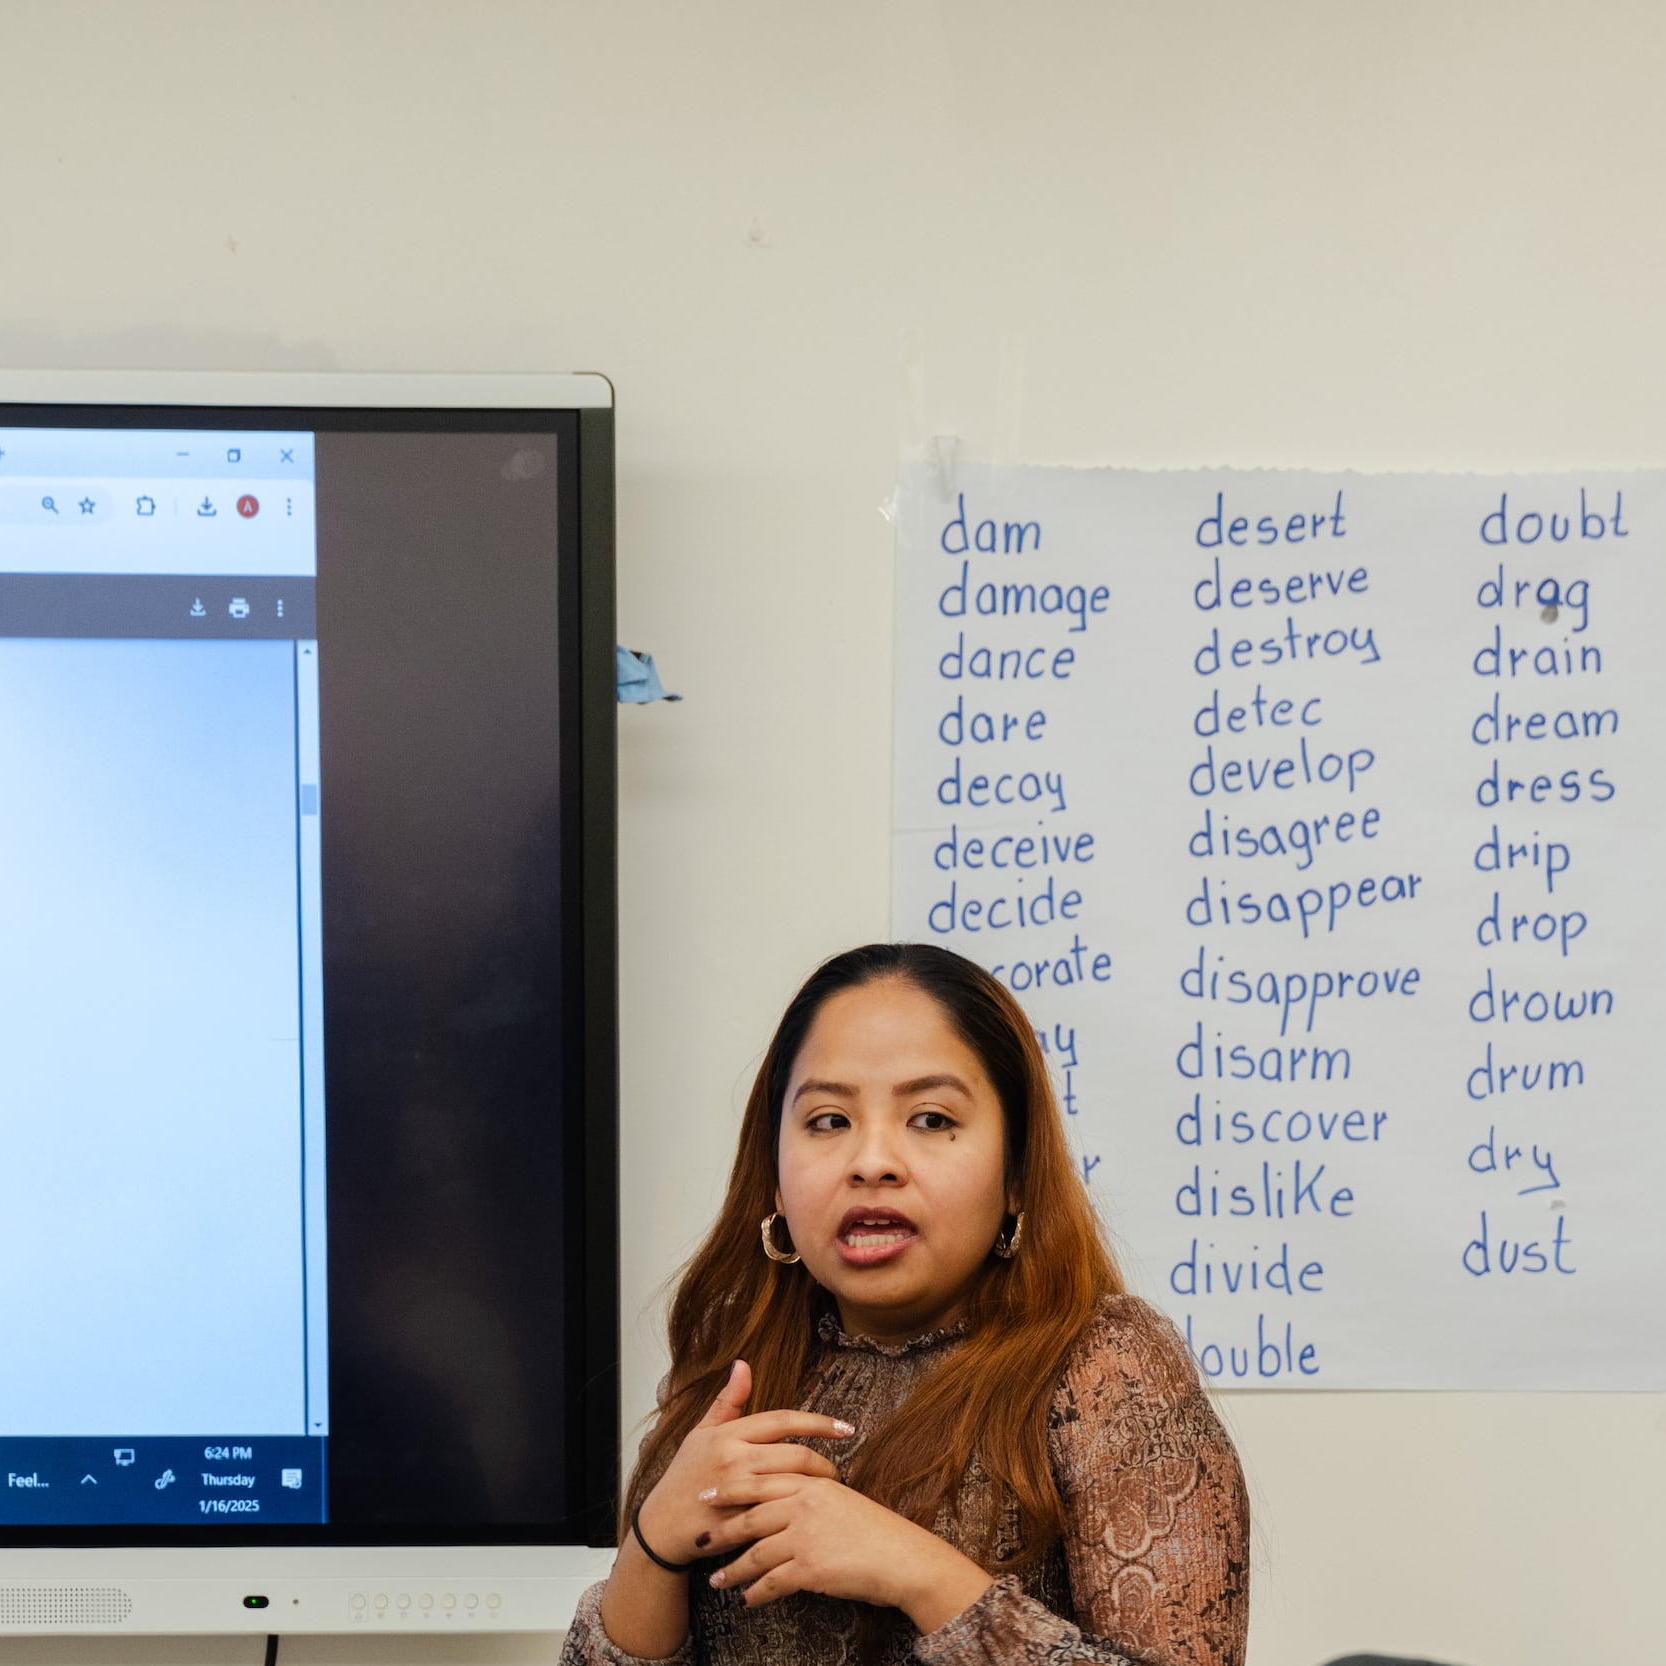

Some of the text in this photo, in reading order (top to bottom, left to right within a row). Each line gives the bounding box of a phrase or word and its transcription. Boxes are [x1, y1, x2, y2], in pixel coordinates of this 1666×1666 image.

[941, 494, 1041, 554] dam
[1196, 491, 1346, 548] desert
[1480, 491, 1628, 544] doubt
[938, 561, 1110, 633] damage
[1194, 559, 1368, 611] deserve
[1477, 564, 1589, 631] drag
[939, 630, 1078, 680] dance
[1194, 618, 1381, 675] destroy
[1473, 623, 1602, 676] drain
[938, 695, 1046, 746] dare
[1194, 685, 1320, 739] detec
[1471, 693, 1619, 746] dream
[937, 757, 1066, 813] decay
[1189, 735, 1374, 797] develop
[1476, 760, 1616, 807] dress
[934, 821, 1094, 871] deceive
[1188, 806, 1380, 871] disagree
[1474, 825, 1570, 893] drip
[928, 877, 1083, 934] decide
[1186, 870, 1421, 938] disappear
[1477, 890, 1588, 957] drop
[989, 935, 1112, 991] orate
[1181, 946, 1420, 1038] disapprove
[1469, 969, 1613, 1023] drown
[1176, 1019, 1350, 1082] disarm
[1466, 1042, 1584, 1100] drum
[1176, 1093, 1387, 1146] discover
[1469, 1128, 1561, 1195] dry
[1170, 1239, 1323, 1295] divide
[1462, 1211, 1575, 1277] dust
[8, 1473, 50, 1488] Feel...
[201, 1473, 255, 1488] Thursday
[204, 1447, 253, 1460] 6:24 PM
[198, 1500, 260, 1514] 1/16/2025
